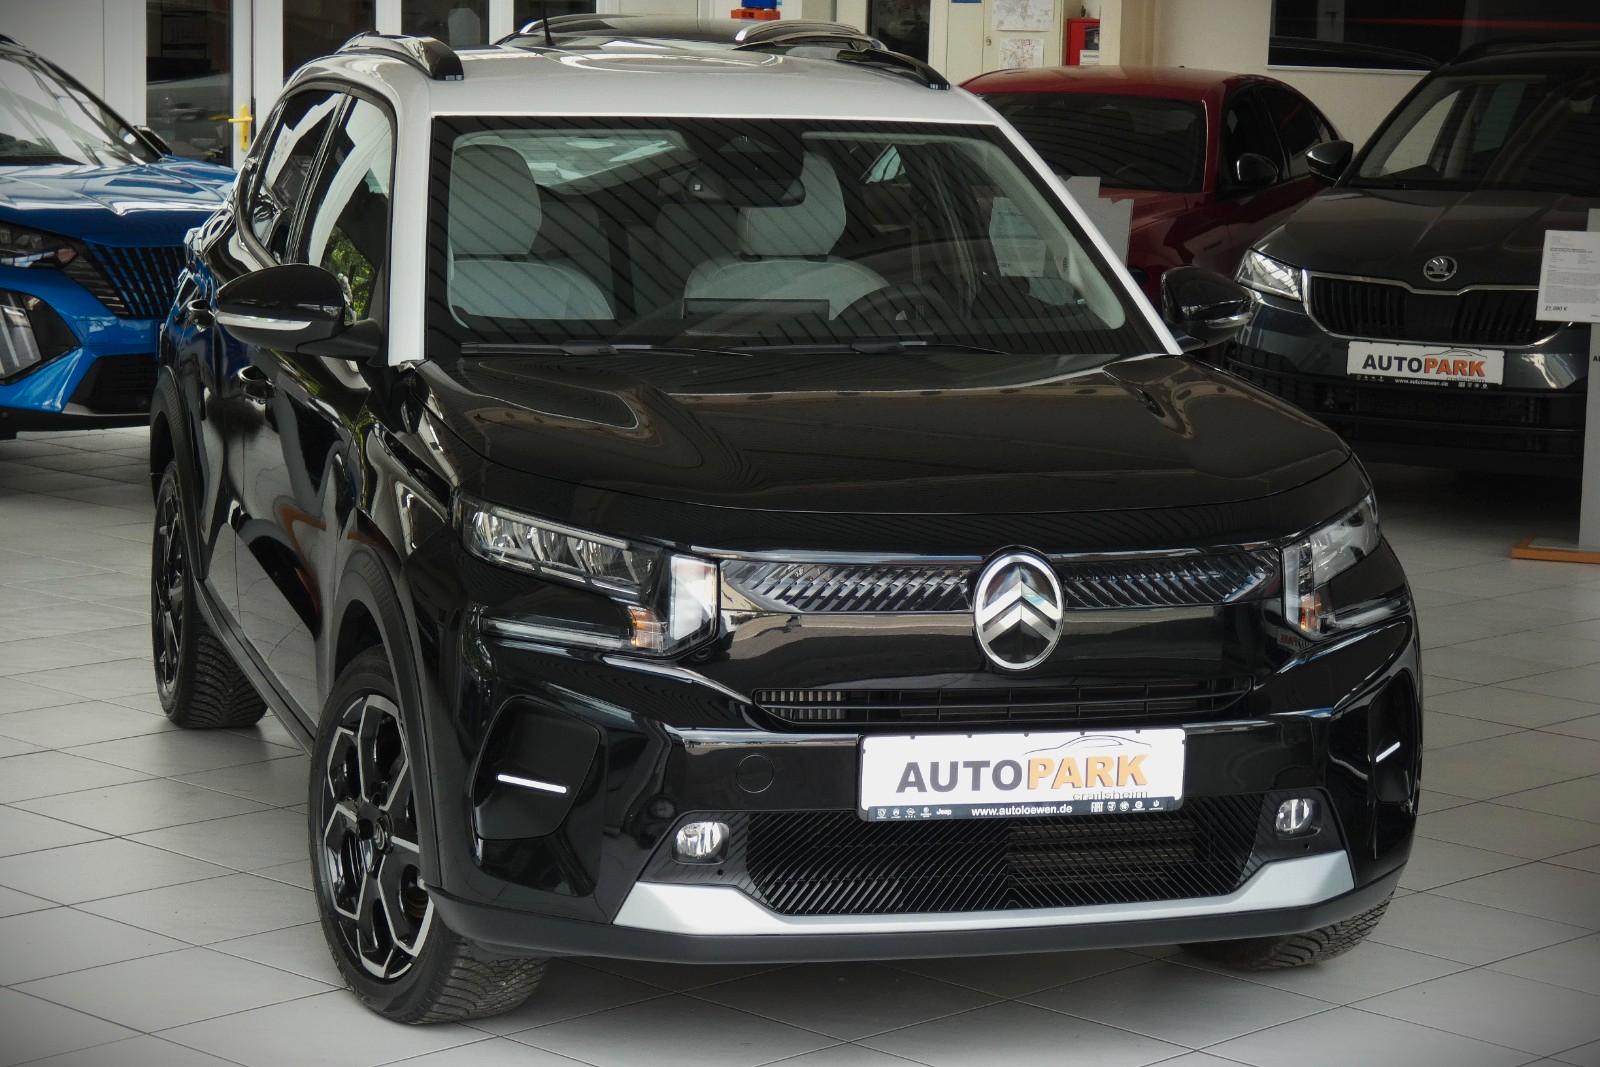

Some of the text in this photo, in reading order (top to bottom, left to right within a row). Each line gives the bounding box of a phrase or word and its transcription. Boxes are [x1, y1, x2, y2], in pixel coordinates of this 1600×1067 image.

[1362, 354, 1486, 377] AUTOPARK
[896, 754, 1149, 794] AUTOPARK
[936, 801, 1104, 817] Jeep www.autoloewen.de FIAT
